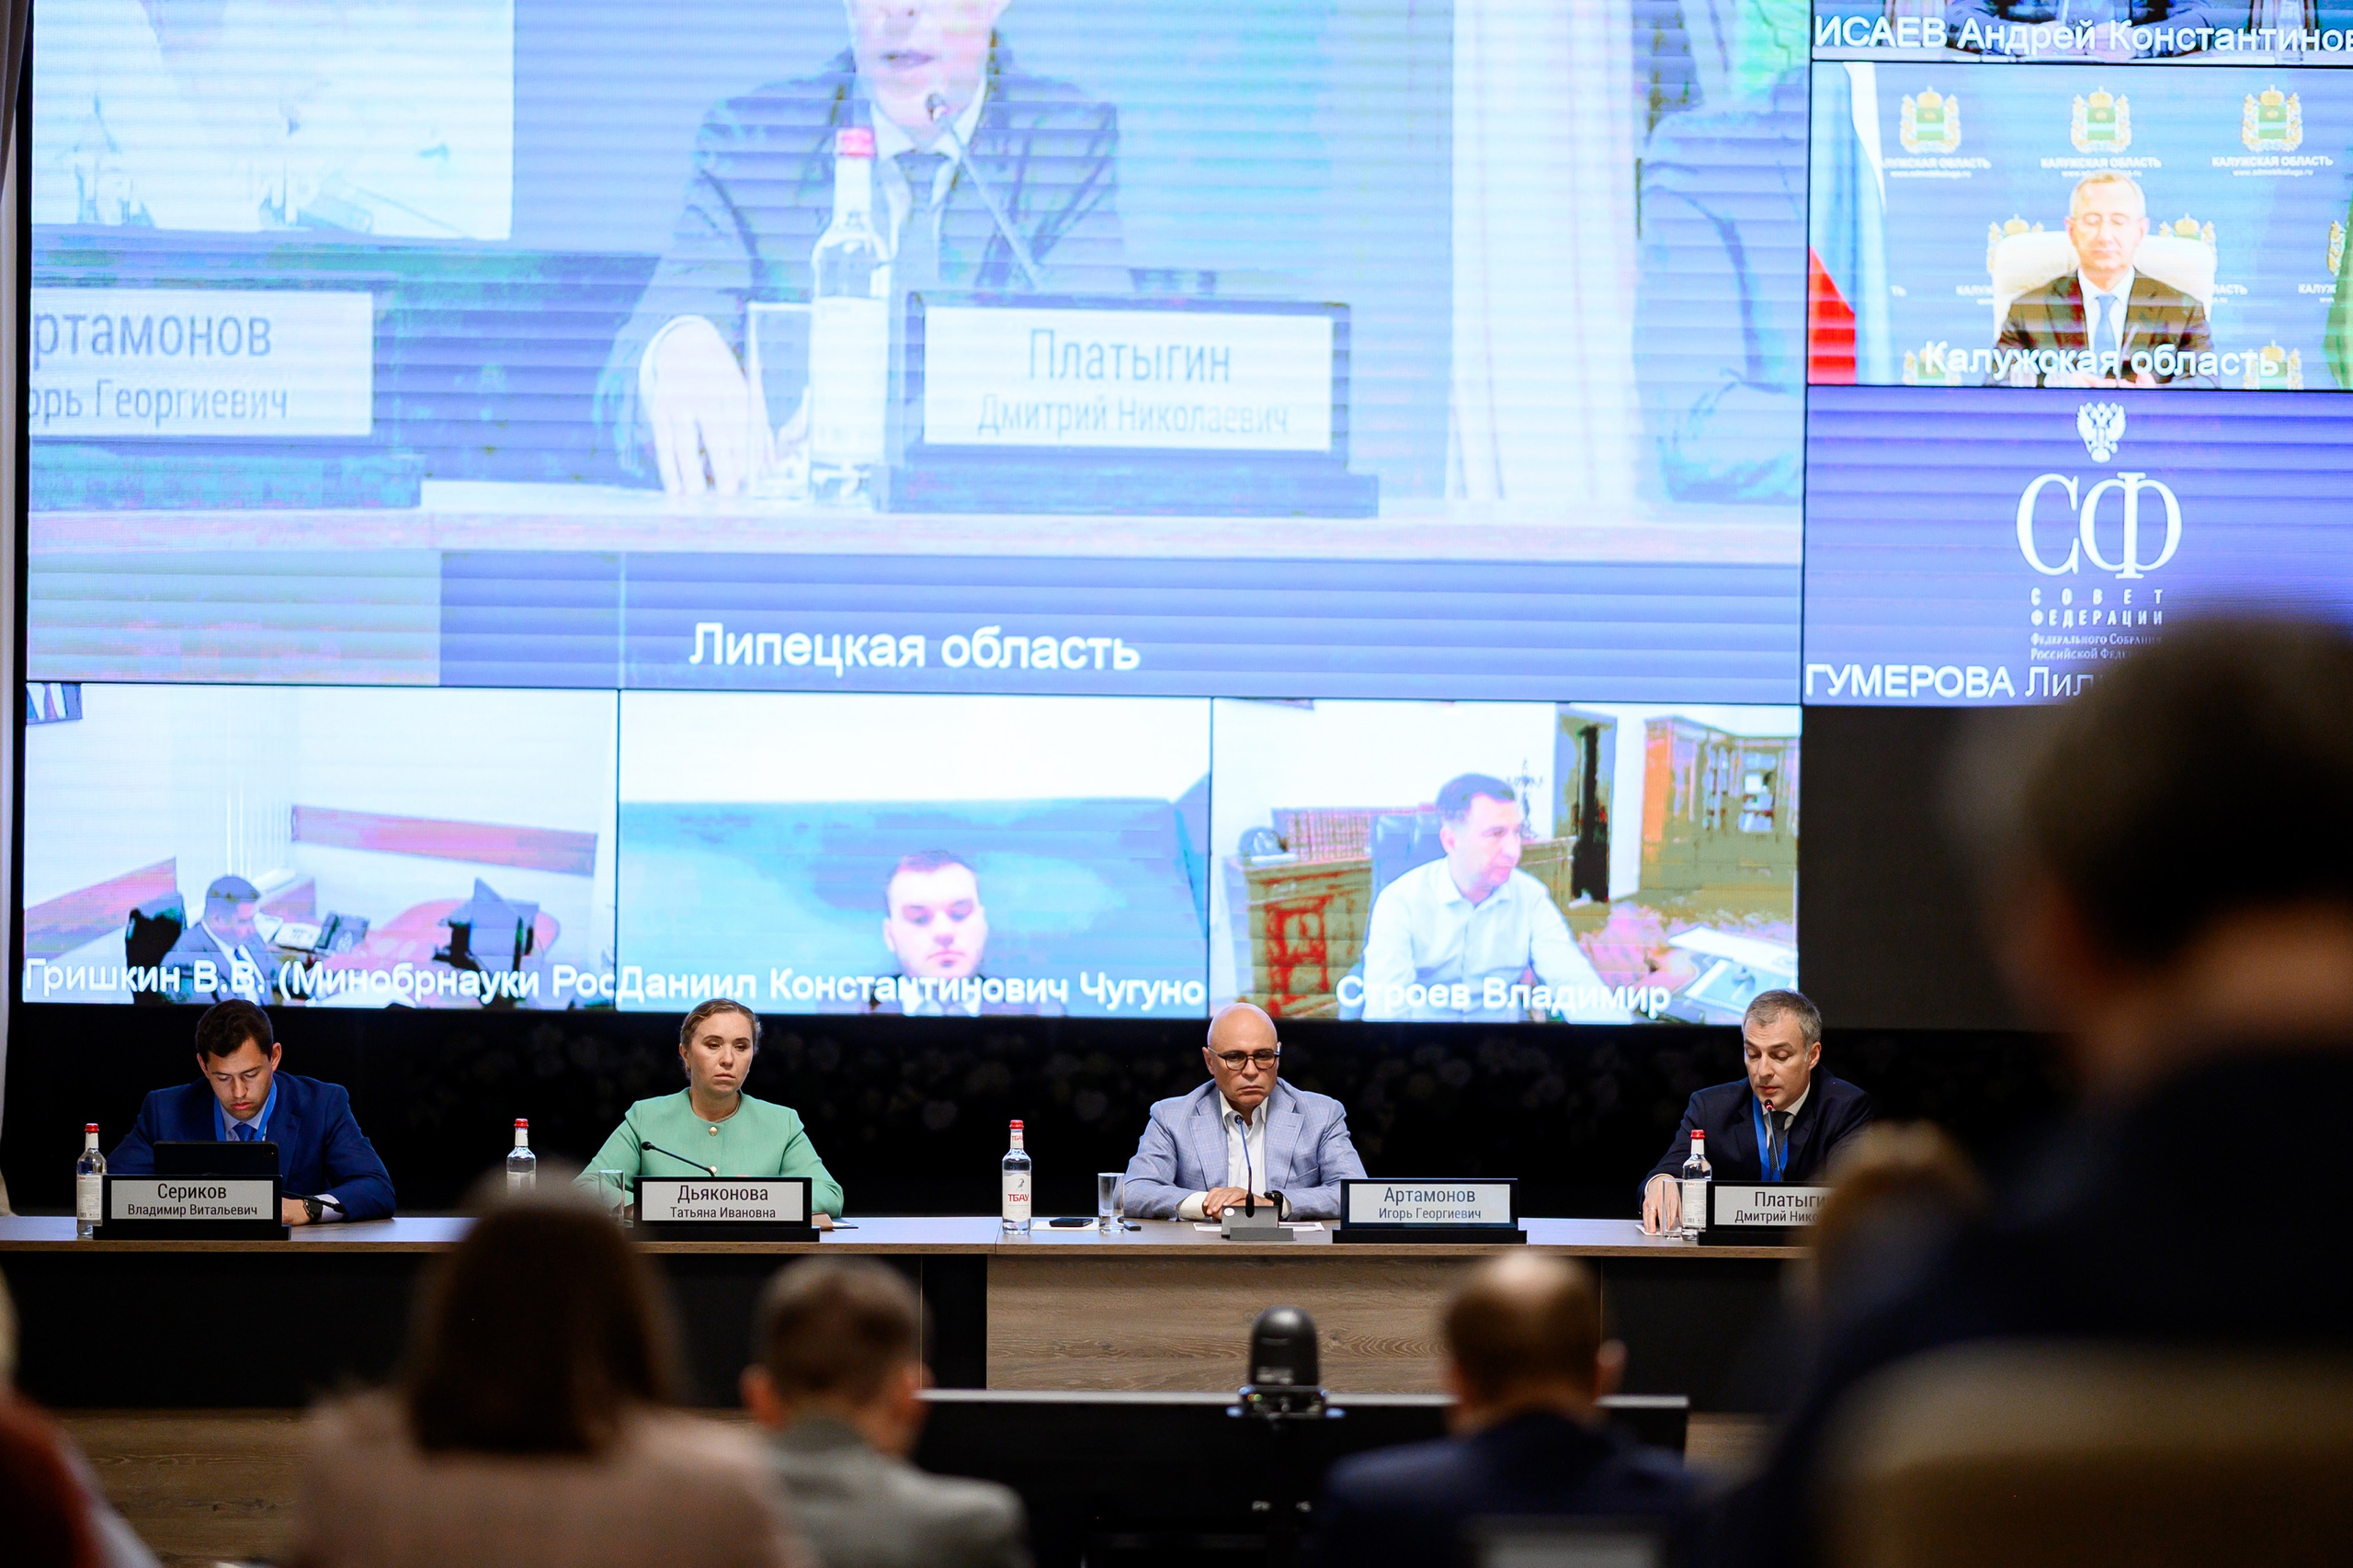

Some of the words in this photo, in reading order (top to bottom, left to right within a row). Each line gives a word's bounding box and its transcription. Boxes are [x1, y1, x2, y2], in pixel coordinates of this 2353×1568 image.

[1814, 16, 1948, 47] ИСАЕВ
[1957, 17, 2096, 56] Андрей
[2280, 155, 2334, 166] ОБЛАСТЬ
[1029, 328, 1231, 383] Платыгин
[1925, 340, 2120, 381] Калужская
[2131, 344, 2279, 377] область
[97, 379, 288, 429] Георгиевич
[978, 394, 1108, 438] Дмитрий
[1118, 397, 1290, 434] Николаевич
[2017, 471, 2183, 580] СФ
[2030, 587, 2164, 607] СОВЕТ
[2030, 609, 2164, 629] ФЕДЕРАЦИИ
[689, 622, 926, 677] Липецкая
[941, 625, 1142, 671] область
[1805, 664, 2017, 698] ГУМЕРОВА
[2024, 665, 2099, 698] Лил
[25, 958, 181, 997] Гришкин
[278, 960, 540, 1005] (Минобрнауки
[616, 965, 757, 1003] Даниил
[770, 968, 1069, 1005] Константинович
[1079, 971, 1206, 1011] Чугуно
[1336, 975, 1471, 1017] Строев
[1483, 977, 1673, 1017] Владимир
[157, 1183, 227, 1202] Сериков
[677, 1184, 768, 1203] Дьяконова
[1383, 1187, 1475, 1206] Артамонов
[1755, 1191, 1827, 1208] Платыги
[128, 1204, 187, 1218] Владимир
[189, 1204, 257, 1216] Витальевич
[670, 1206, 717, 1218] Татьяна
[720, 1206, 776, 1219] Ивановна
[1379, 1208, 1413, 1221] Игорь
[1415, 1208, 1481, 1221] Георгиевич
[1734, 1210, 1787, 1224] Дмитрий
[1790, 1212, 1820, 1223] Нико
